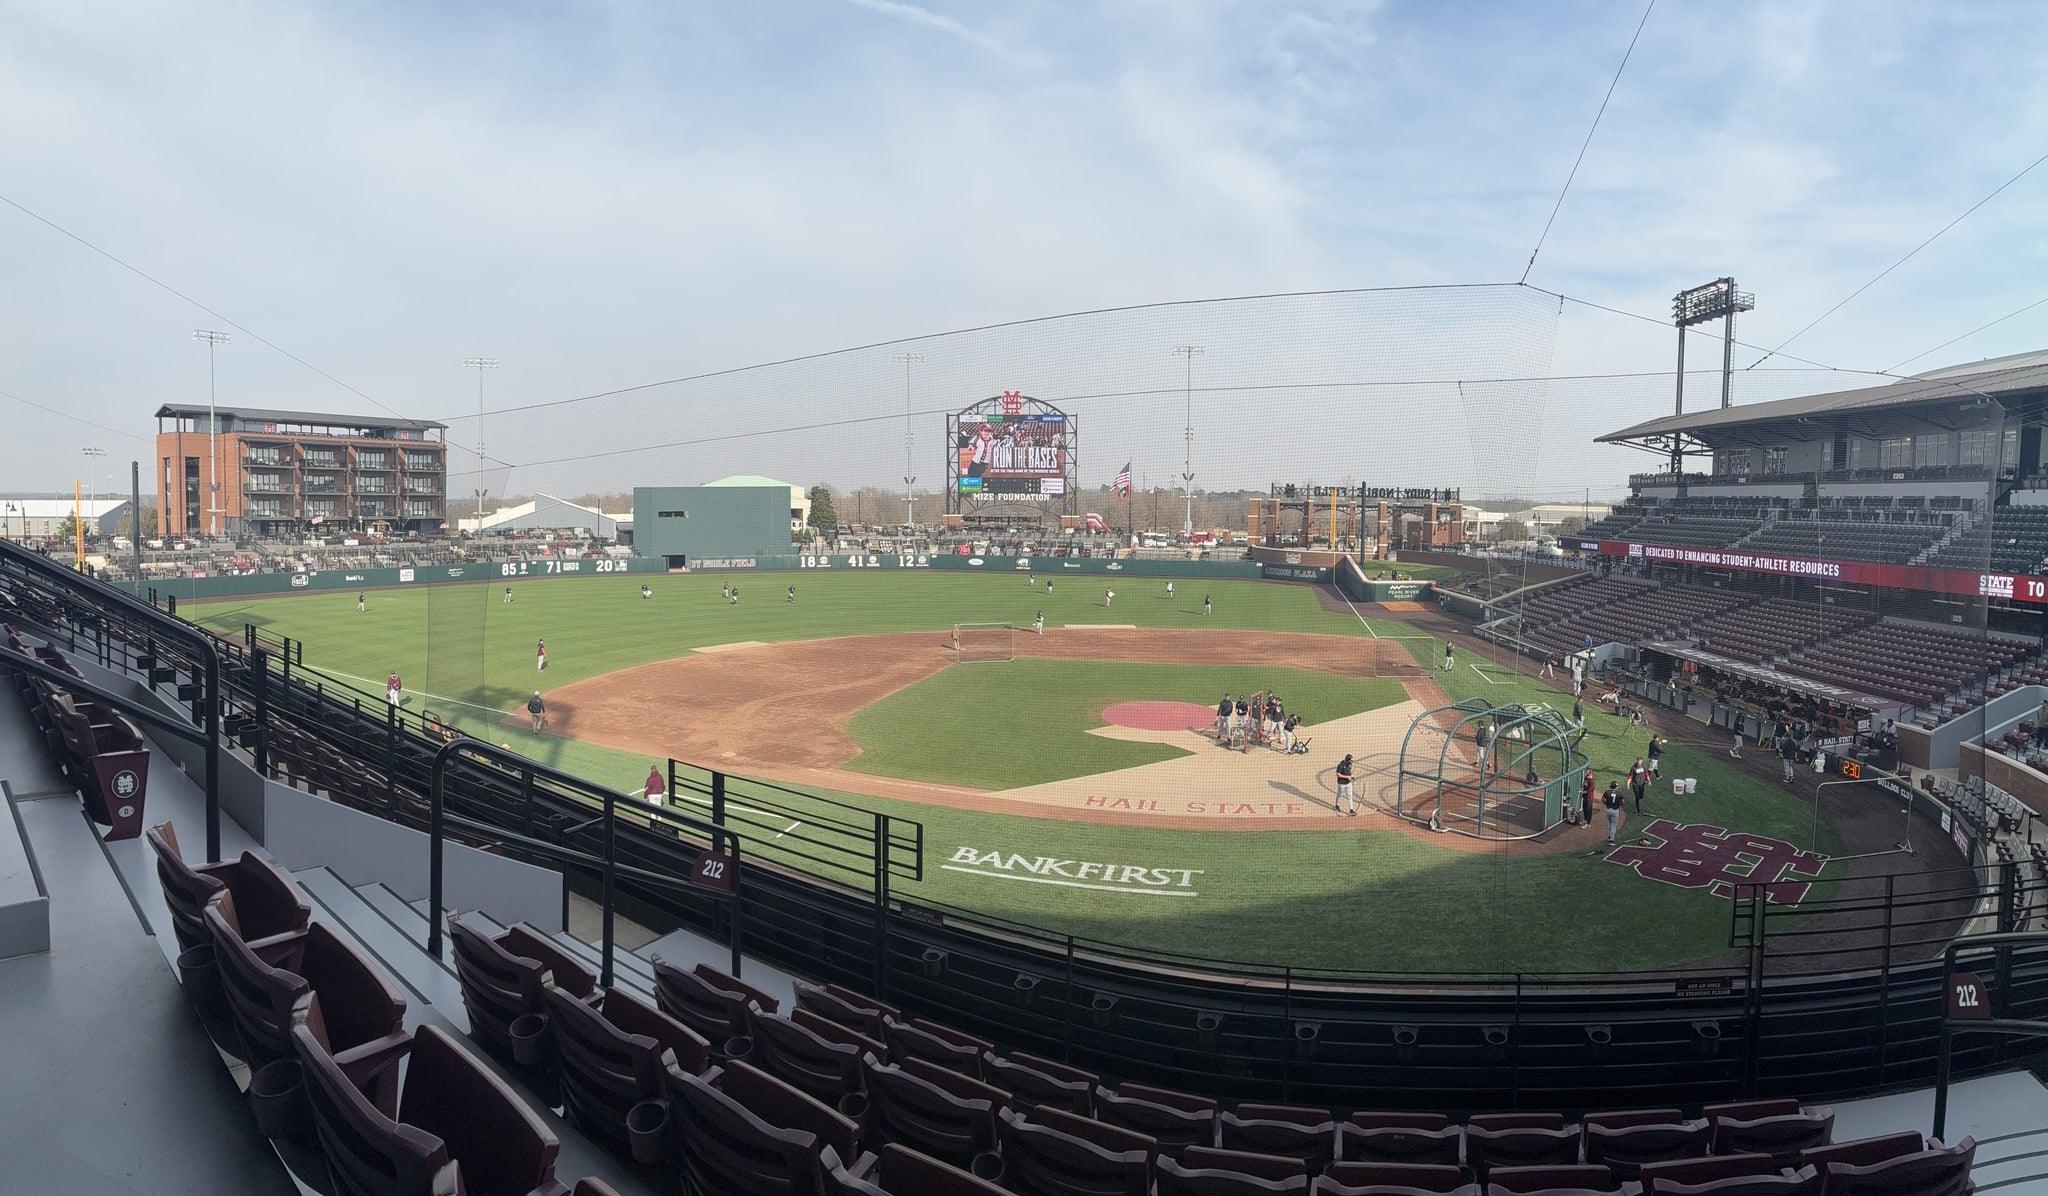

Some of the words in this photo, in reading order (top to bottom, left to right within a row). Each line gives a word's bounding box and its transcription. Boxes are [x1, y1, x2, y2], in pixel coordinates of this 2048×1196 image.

[993, 447, 1013, 469] RUN
[1014, 447, 1027, 469] THE
[1029, 447, 1058, 469] BASES
[973, 493, 994, 501] MIZE
[998, 493, 1050, 501] FOUNDATION
[547, 561, 561, 573] 71
[596, 560, 612, 571] 20
[801, 556, 815, 568] 18
[848, 555, 863, 567] 41
[899, 555, 914, 567] 12
[1646, 547, 1674, 559] DEDICATED
[1676, 550, 1684, 560] TO
[1685, 551, 1720, 564] ENHANCING
[1722, 554, 1787, 571] STUDENT-ATHLETE
[1790, 560, 1840, 577] RESOURCES
[502, 563, 516, 576] 85
[1980, 575, 2014, 589] STATE
[2028, 581, 2045, 597] TO
[1878, 778, 1900, 794] BULLDOG
[1085, 795, 1167, 813] HAIL
[1186, 802, 1305, 815] STATE
[702, 859, 724, 879] 212
[948, 846, 1204, 887] BANKFIRST
[1956, 984, 1979, 1007] 212
